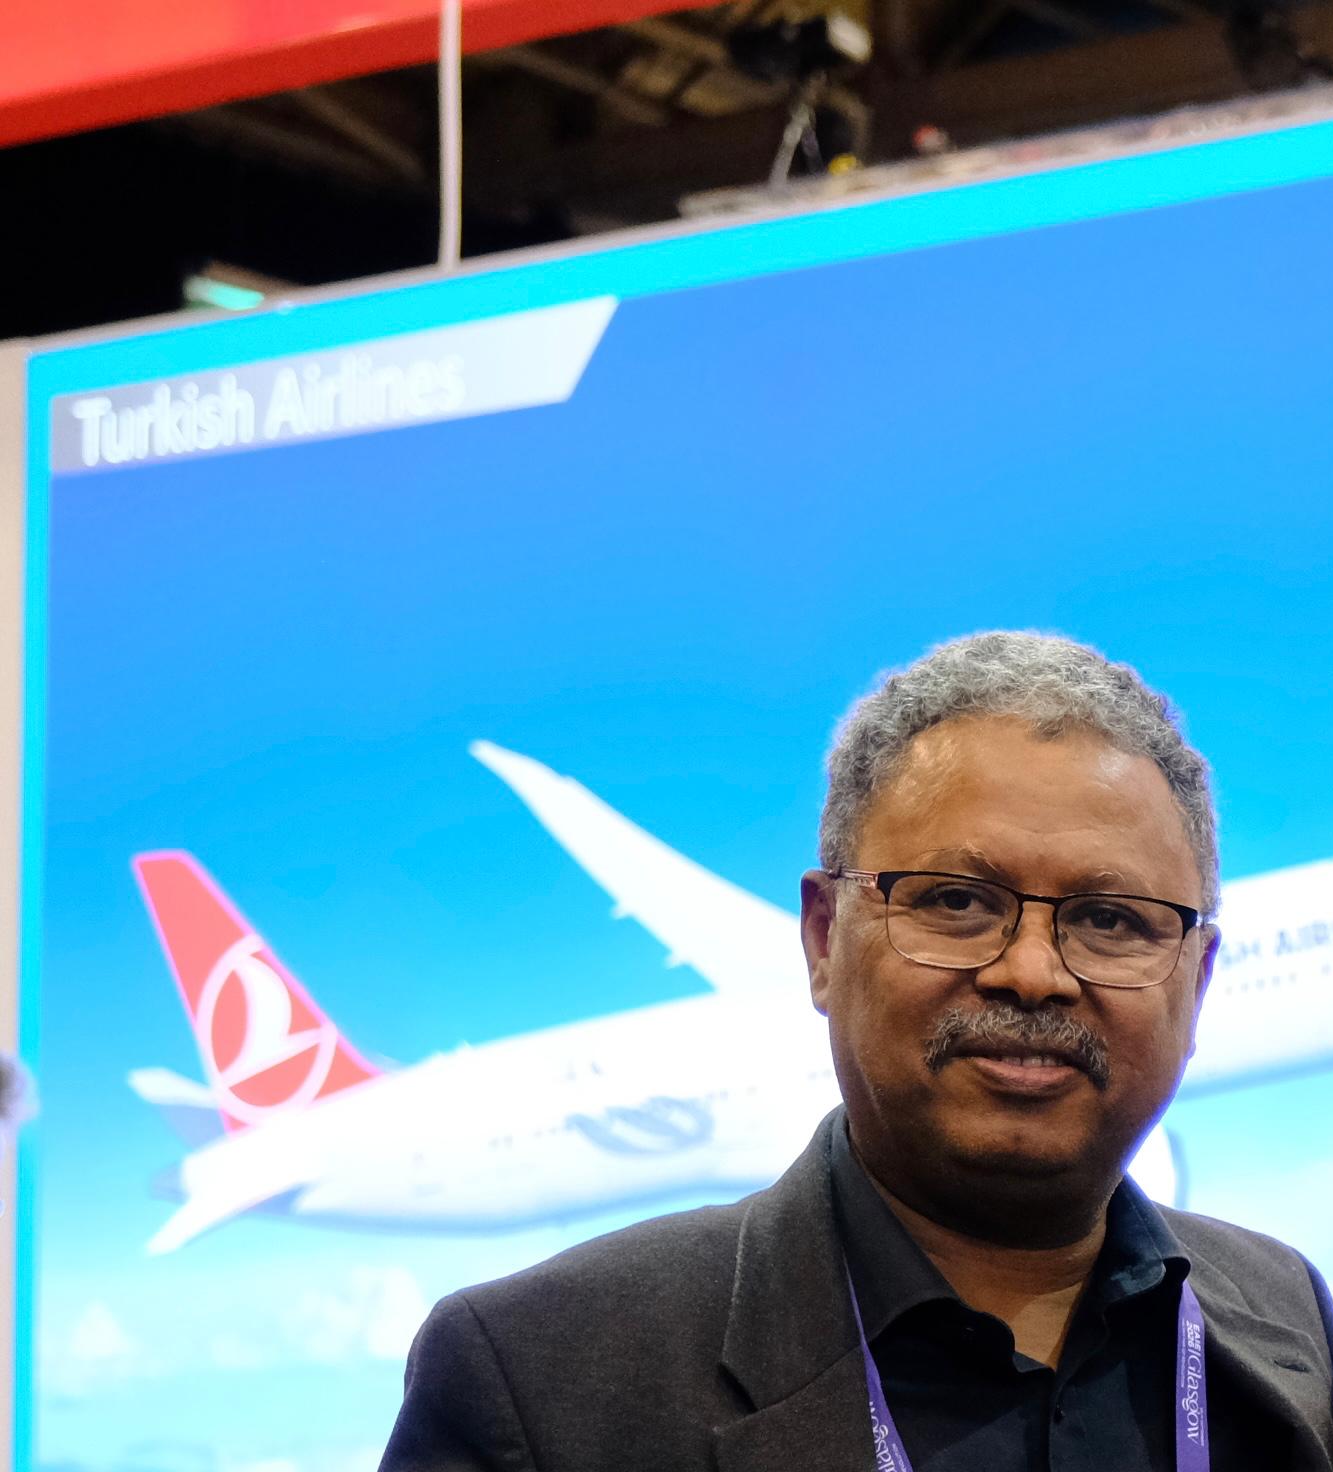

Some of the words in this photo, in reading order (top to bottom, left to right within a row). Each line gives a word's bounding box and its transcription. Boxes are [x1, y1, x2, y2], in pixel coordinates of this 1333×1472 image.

[72, 373, 255, 467] Turkish
[263, 352, 467, 441] Airlines
[1182, 1353, 1203, 1446] Glasgow
